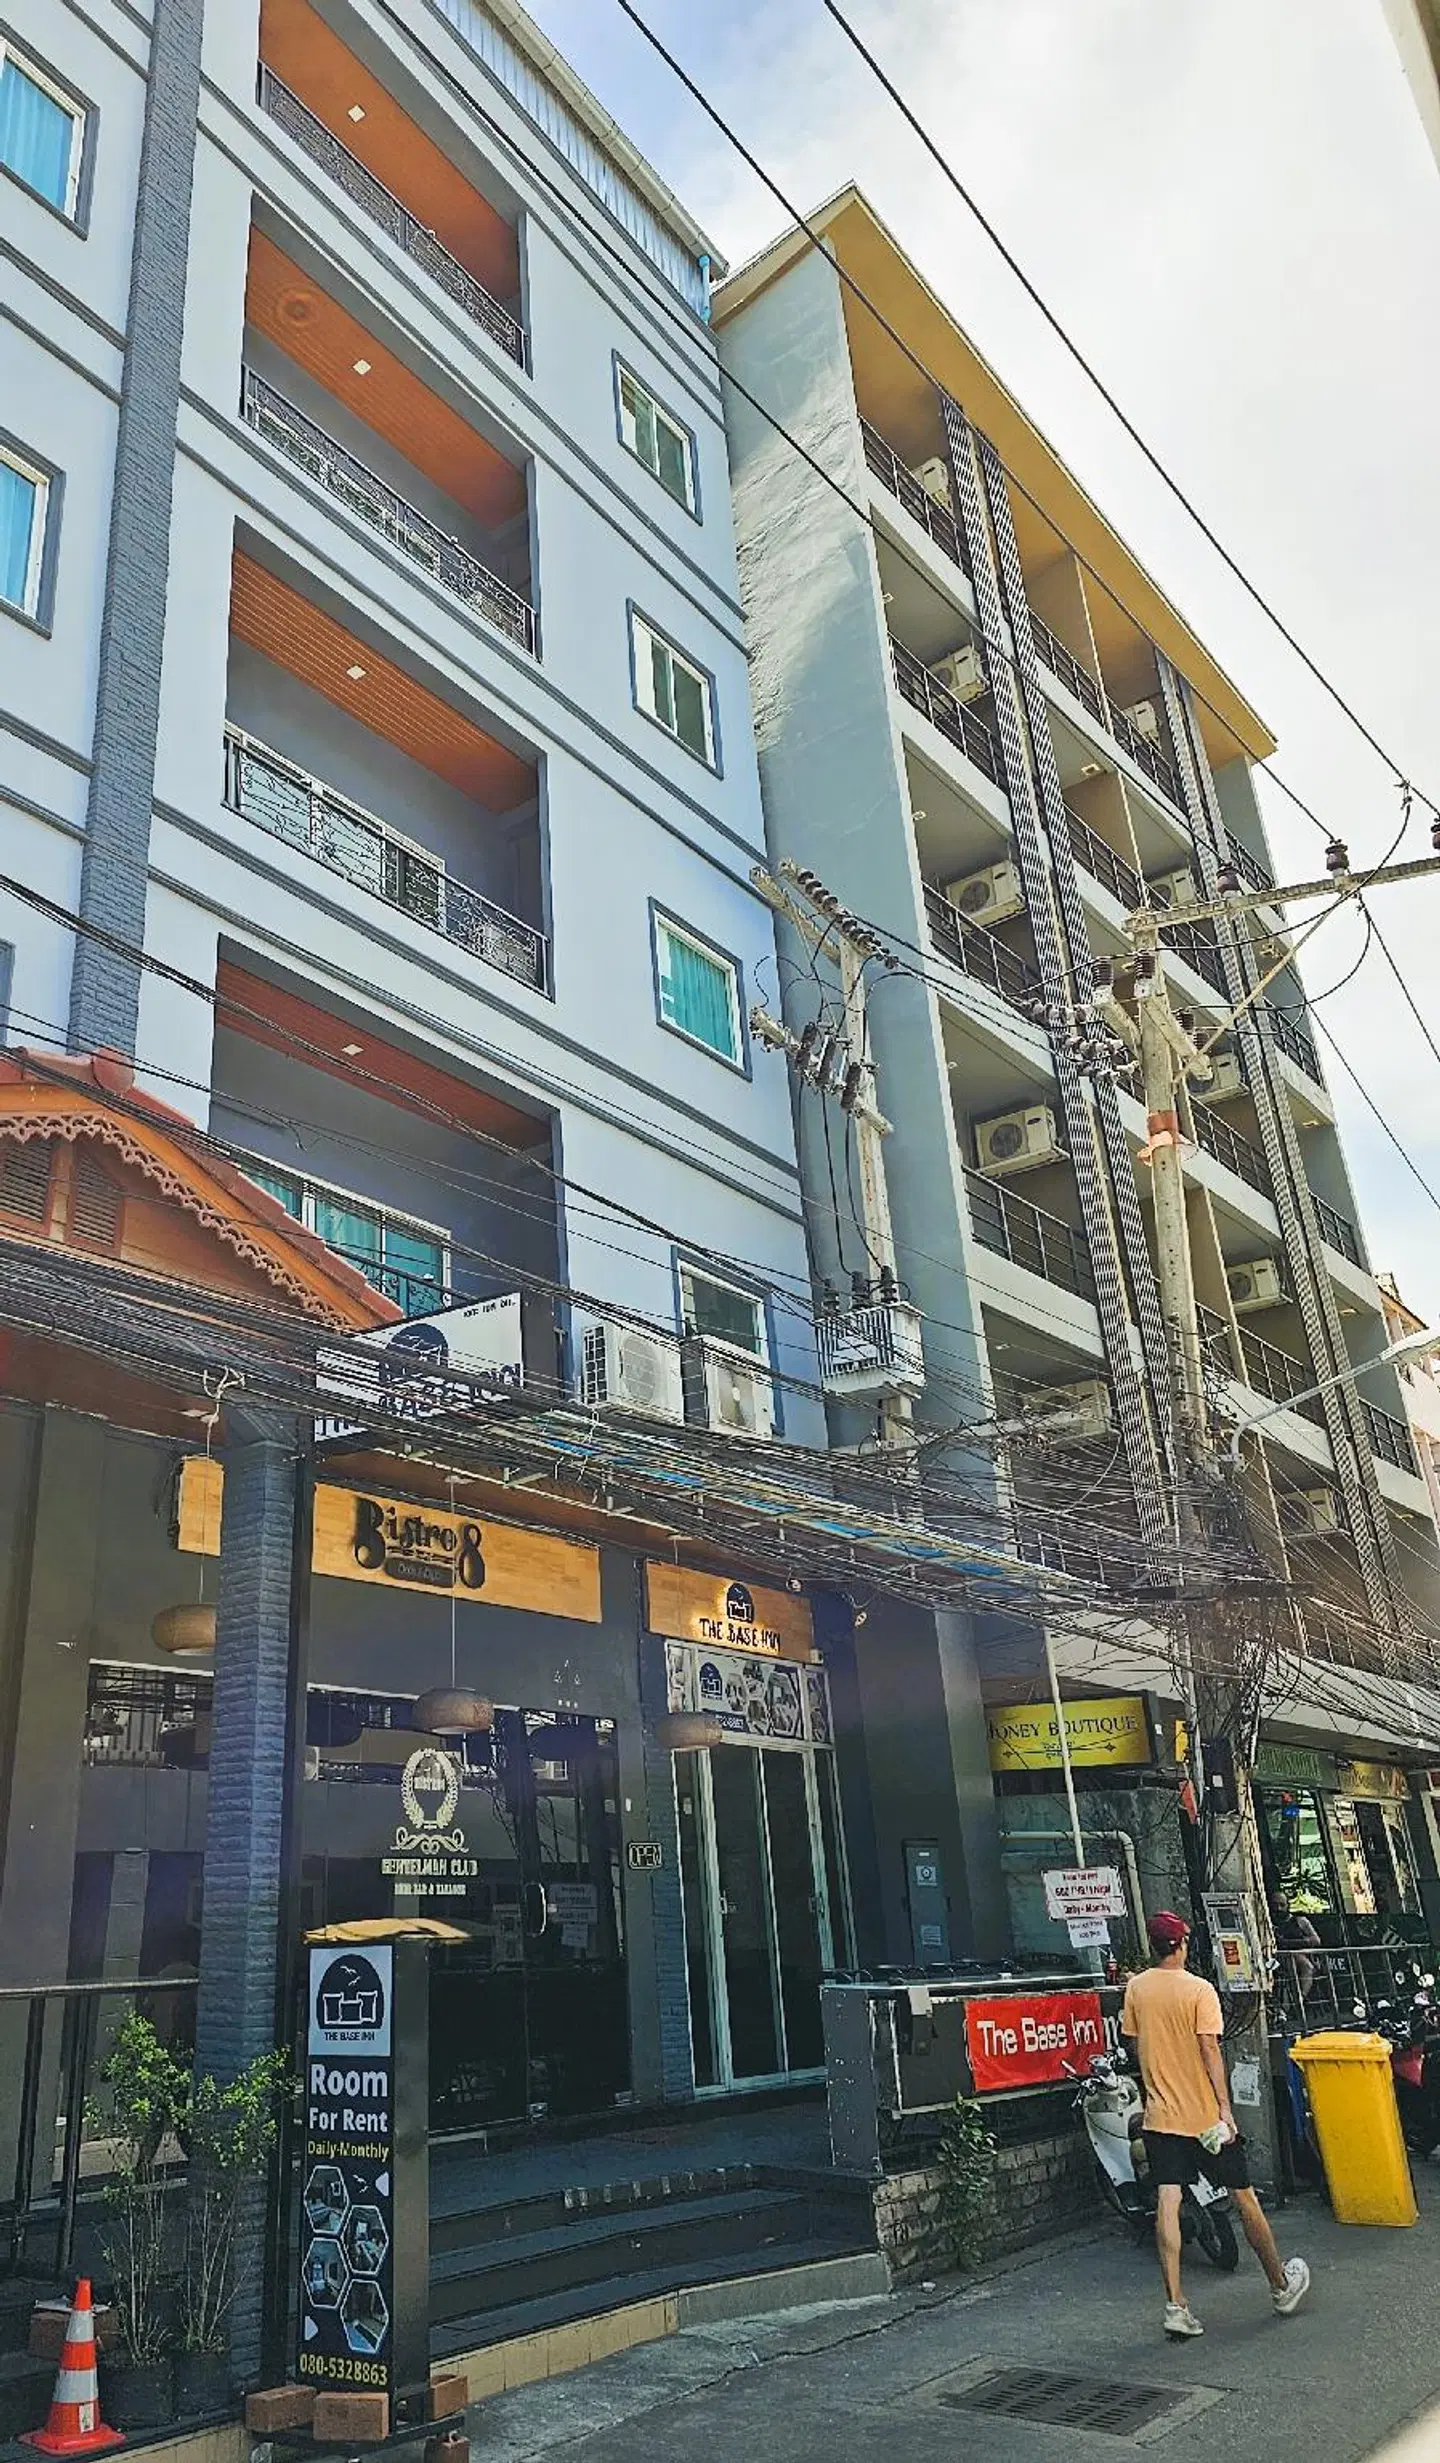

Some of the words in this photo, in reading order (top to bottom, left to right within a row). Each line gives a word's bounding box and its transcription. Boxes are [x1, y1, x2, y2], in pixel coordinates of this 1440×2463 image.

[700, 1618, 722, 1640] THE
[728, 1623, 759, 1647] BASE
[1049, 1714, 1139, 1737] BOUTIQUE
[630, 1844, 661, 1867] OPEN
[324, 2031, 338, 2041] THE
[340, 2031, 360, 2041] BASE
[976, 2020, 1018, 2057] The
[1021, 2016, 1068, 2053] Base
[1070, 2012, 1098, 2046] Inn
[310, 2063, 388, 2097] Room
[309, 2106, 338, 2131] For
[343, 2108, 388, 2133] Rent
[307, 2140, 389, 2163] Daily-Monthly
[300, 2353, 388, 2386] 080-5328863
